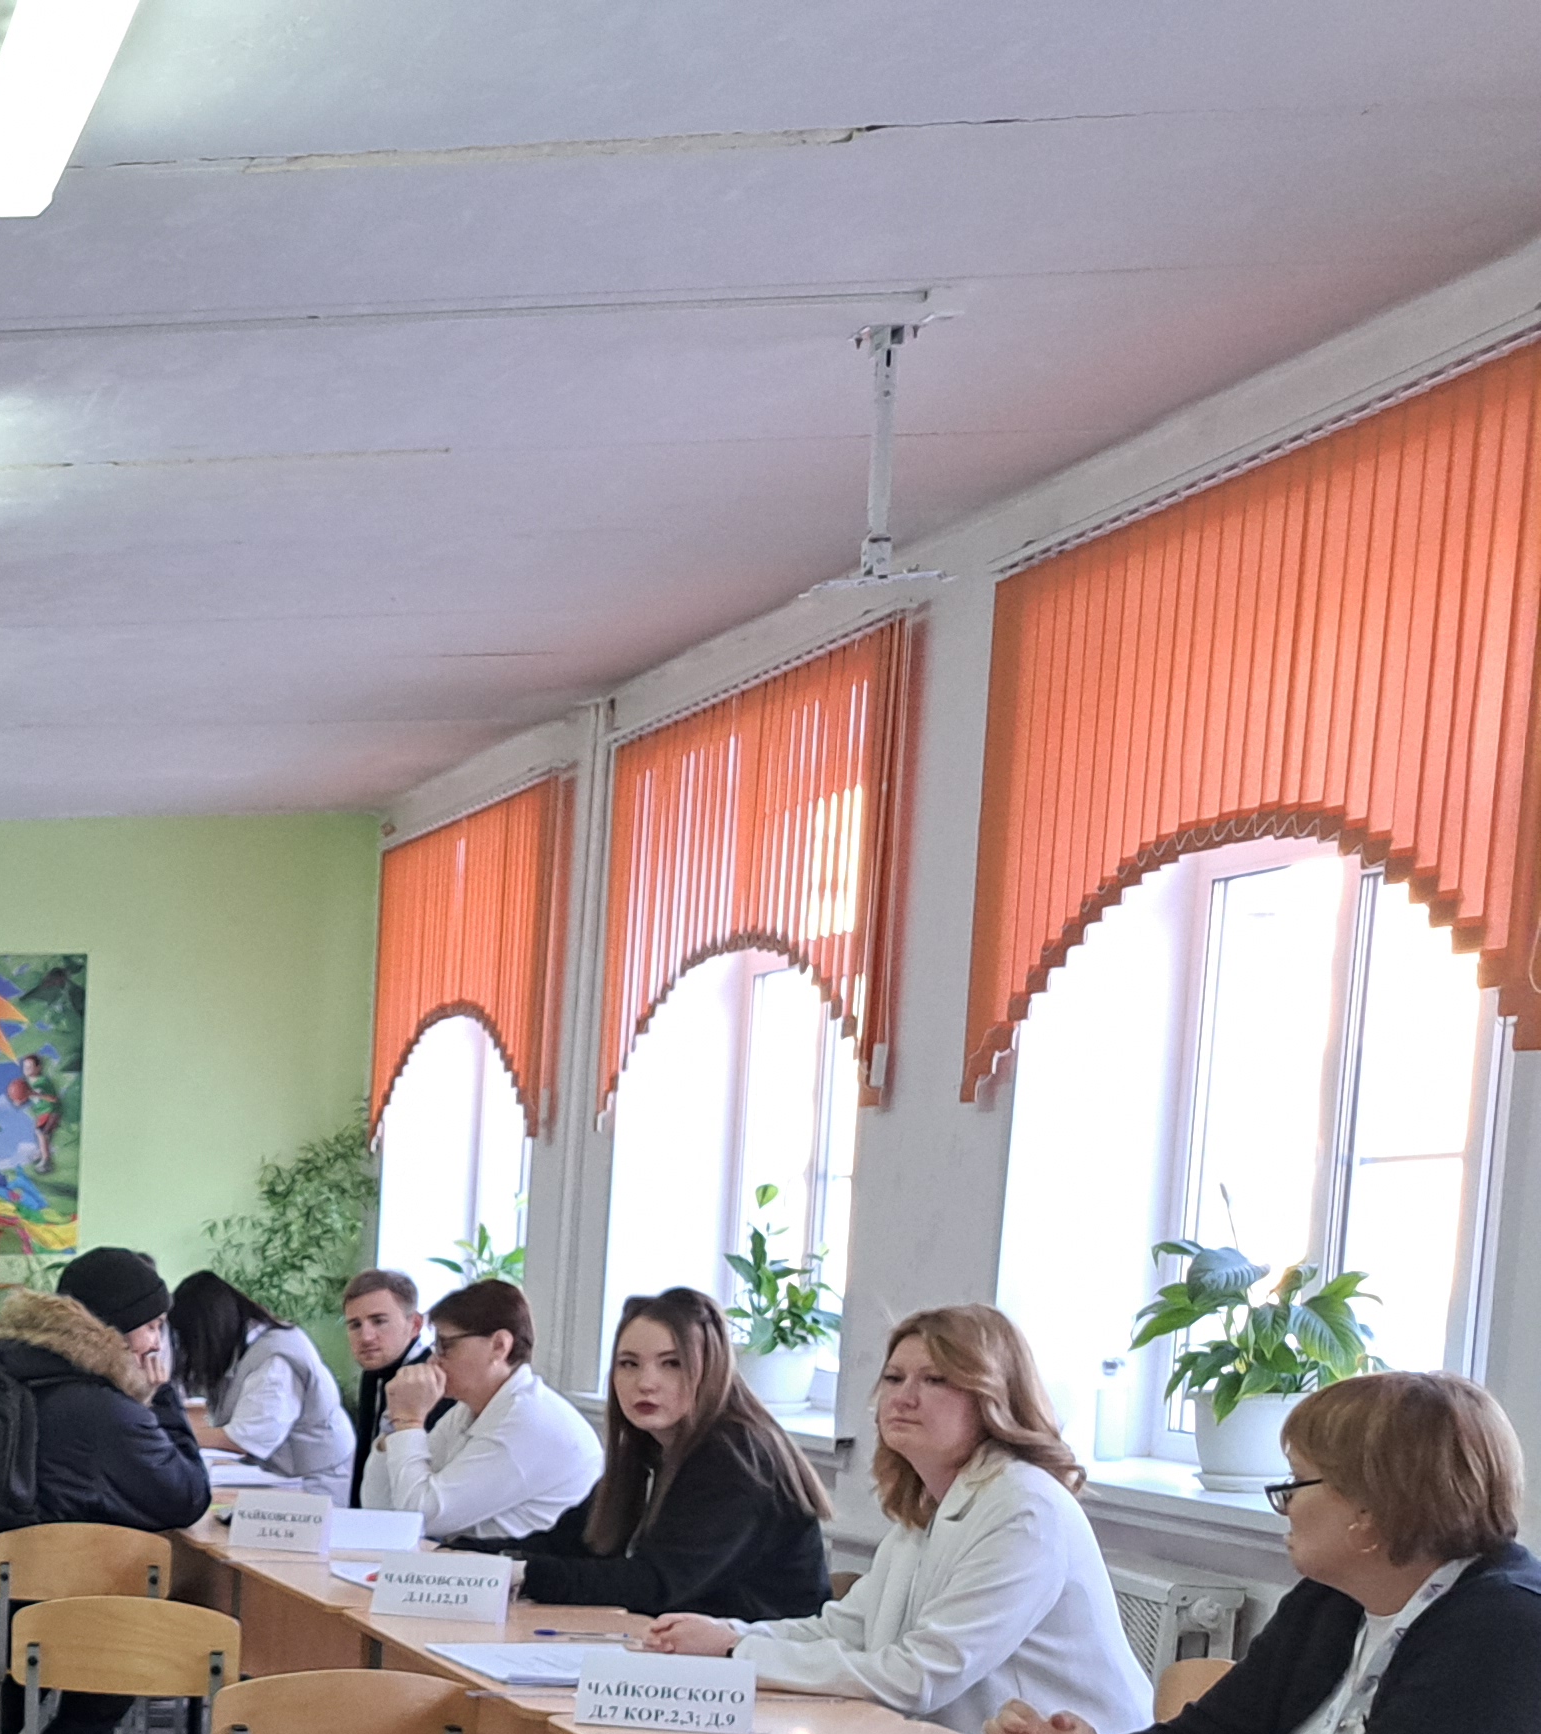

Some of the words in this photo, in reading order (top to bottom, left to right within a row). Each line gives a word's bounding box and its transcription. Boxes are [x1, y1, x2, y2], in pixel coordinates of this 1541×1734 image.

[384, 1572, 499, 1588] ЧАЙКОВСКОГО
[587, 1681, 746, 1704] ЧАЙКОВСКОГО
[588, 1704, 619, 1719] Д.7
[704, 1712, 736, 1728] Д.9
